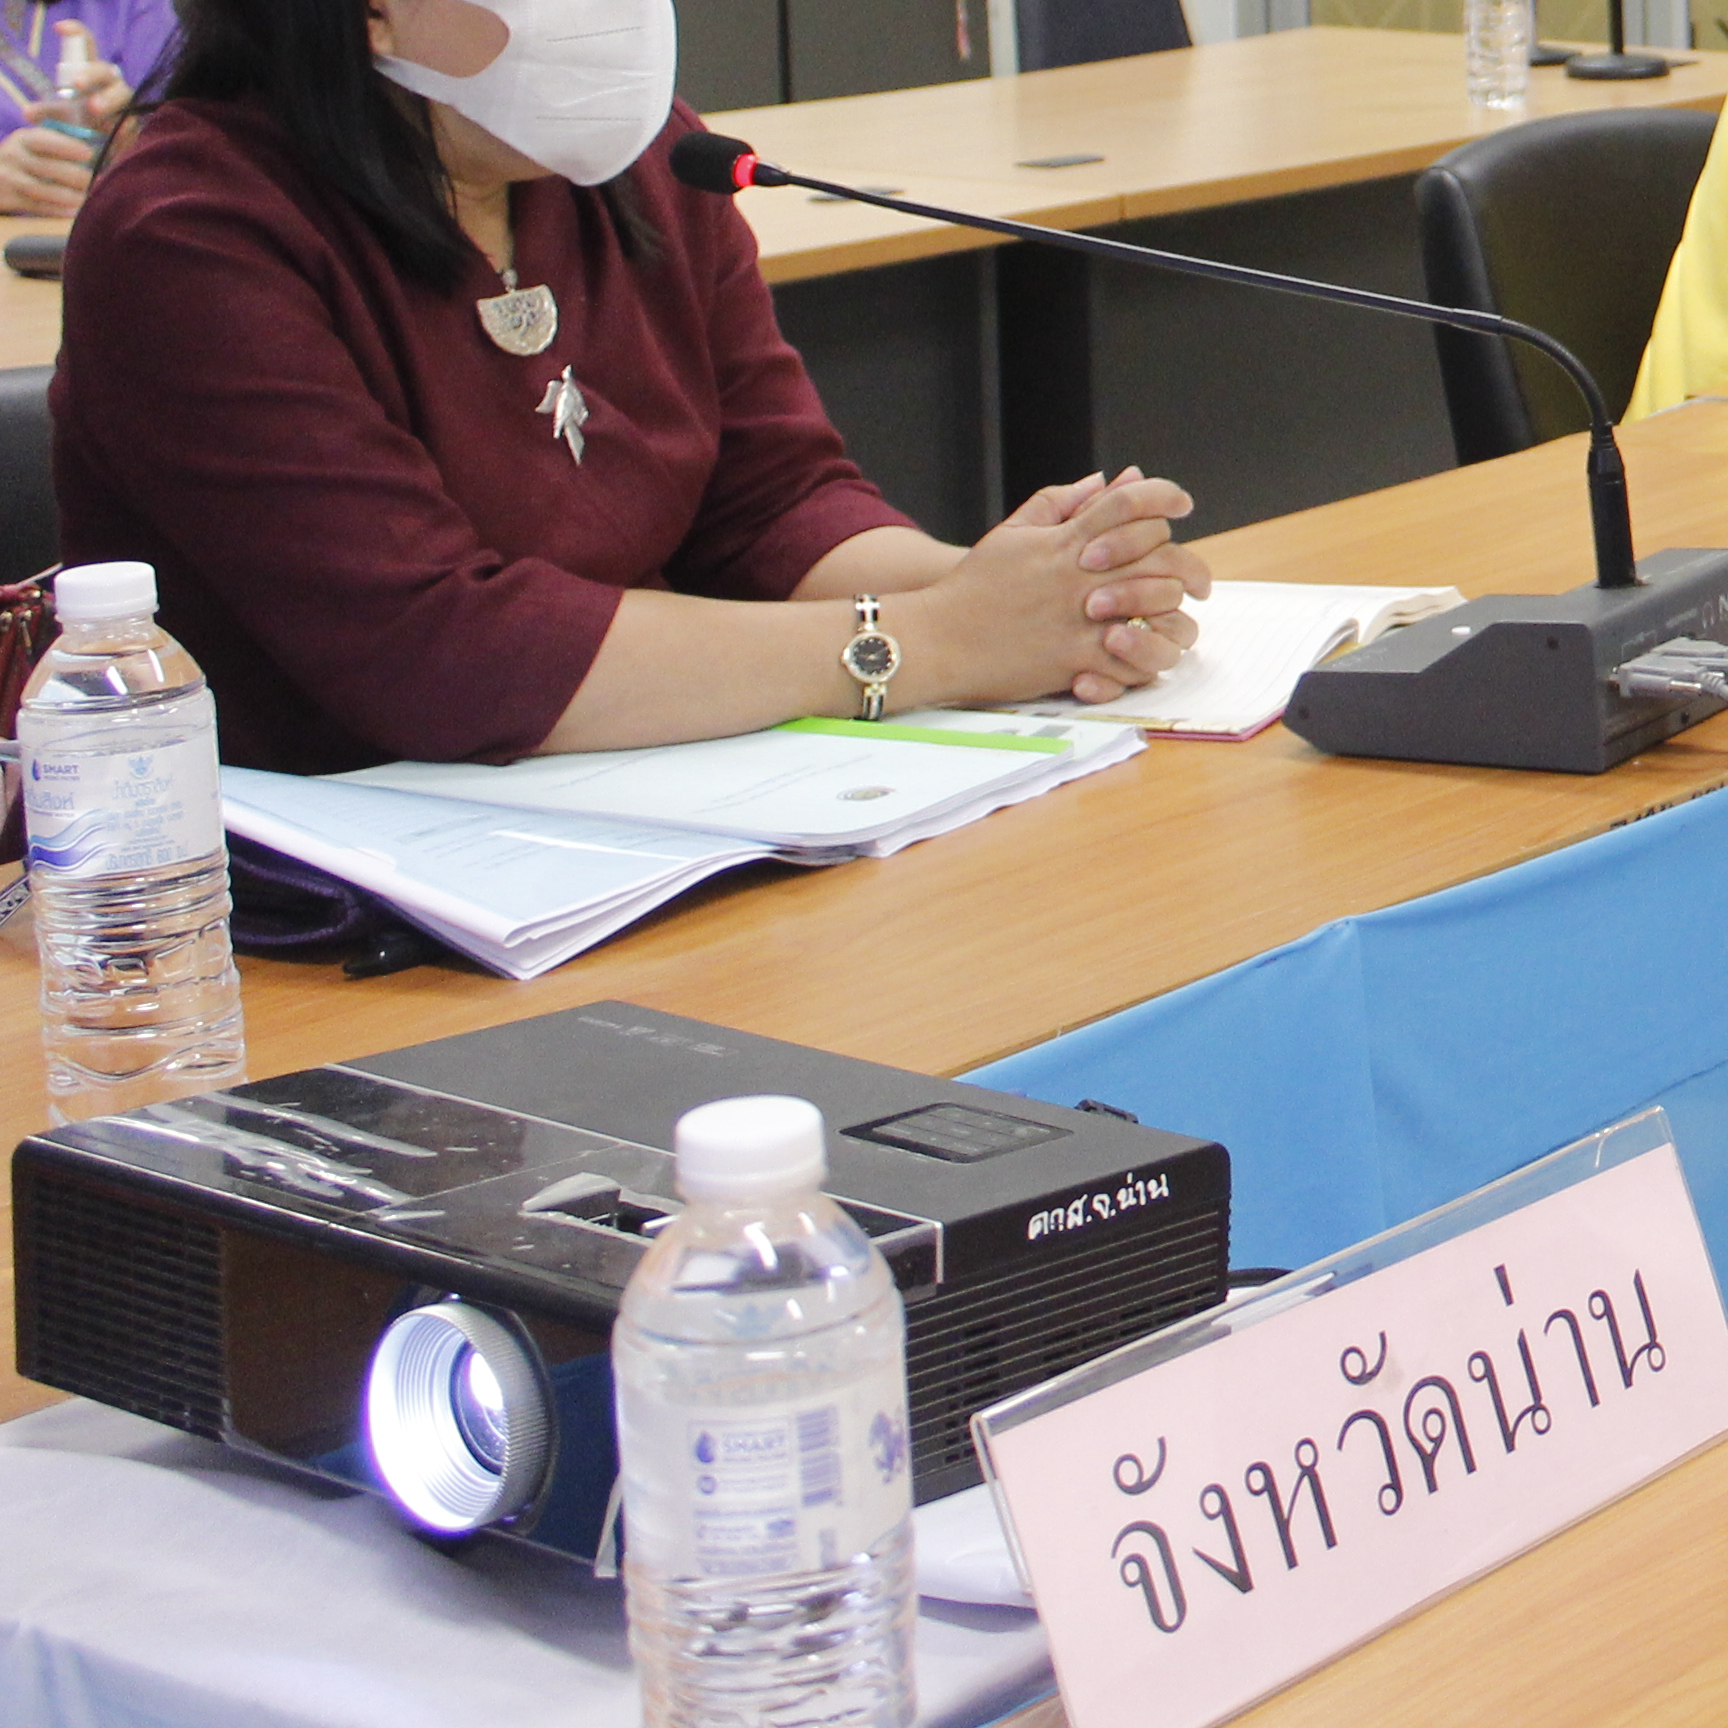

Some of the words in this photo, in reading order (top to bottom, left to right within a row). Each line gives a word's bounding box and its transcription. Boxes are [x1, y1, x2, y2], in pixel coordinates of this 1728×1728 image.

[43, 765, 80, 775] SMART
[1110, 1263, 1667, 1634] จังหวัดน่าน
